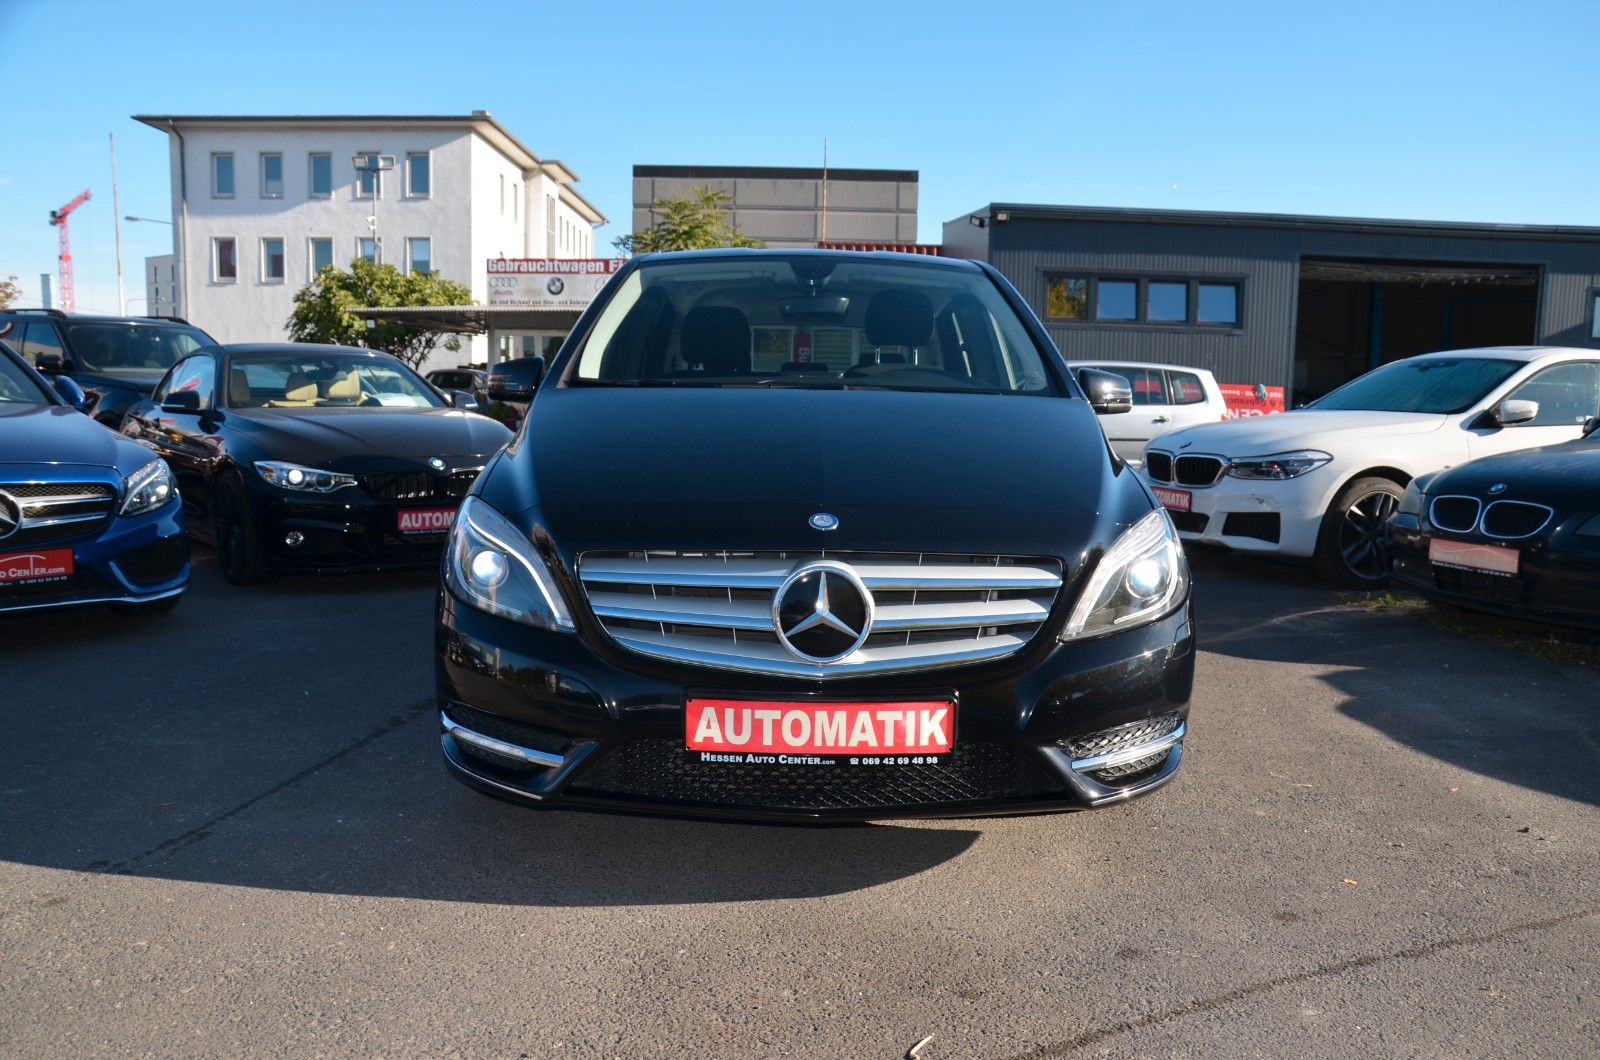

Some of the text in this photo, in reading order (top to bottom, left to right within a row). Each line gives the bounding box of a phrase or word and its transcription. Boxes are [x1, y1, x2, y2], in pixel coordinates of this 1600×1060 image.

[488, 259, 604, 273] Gebrauchtwagen
[400, 511, 455, 528] AUTOM
[693, 706, 949, 748] AUTOMATIK
[701, 752, 836, 766] HESSEN AUTO CENTER.com
[862, 755, 938, 765] 069 42 69 48 98
